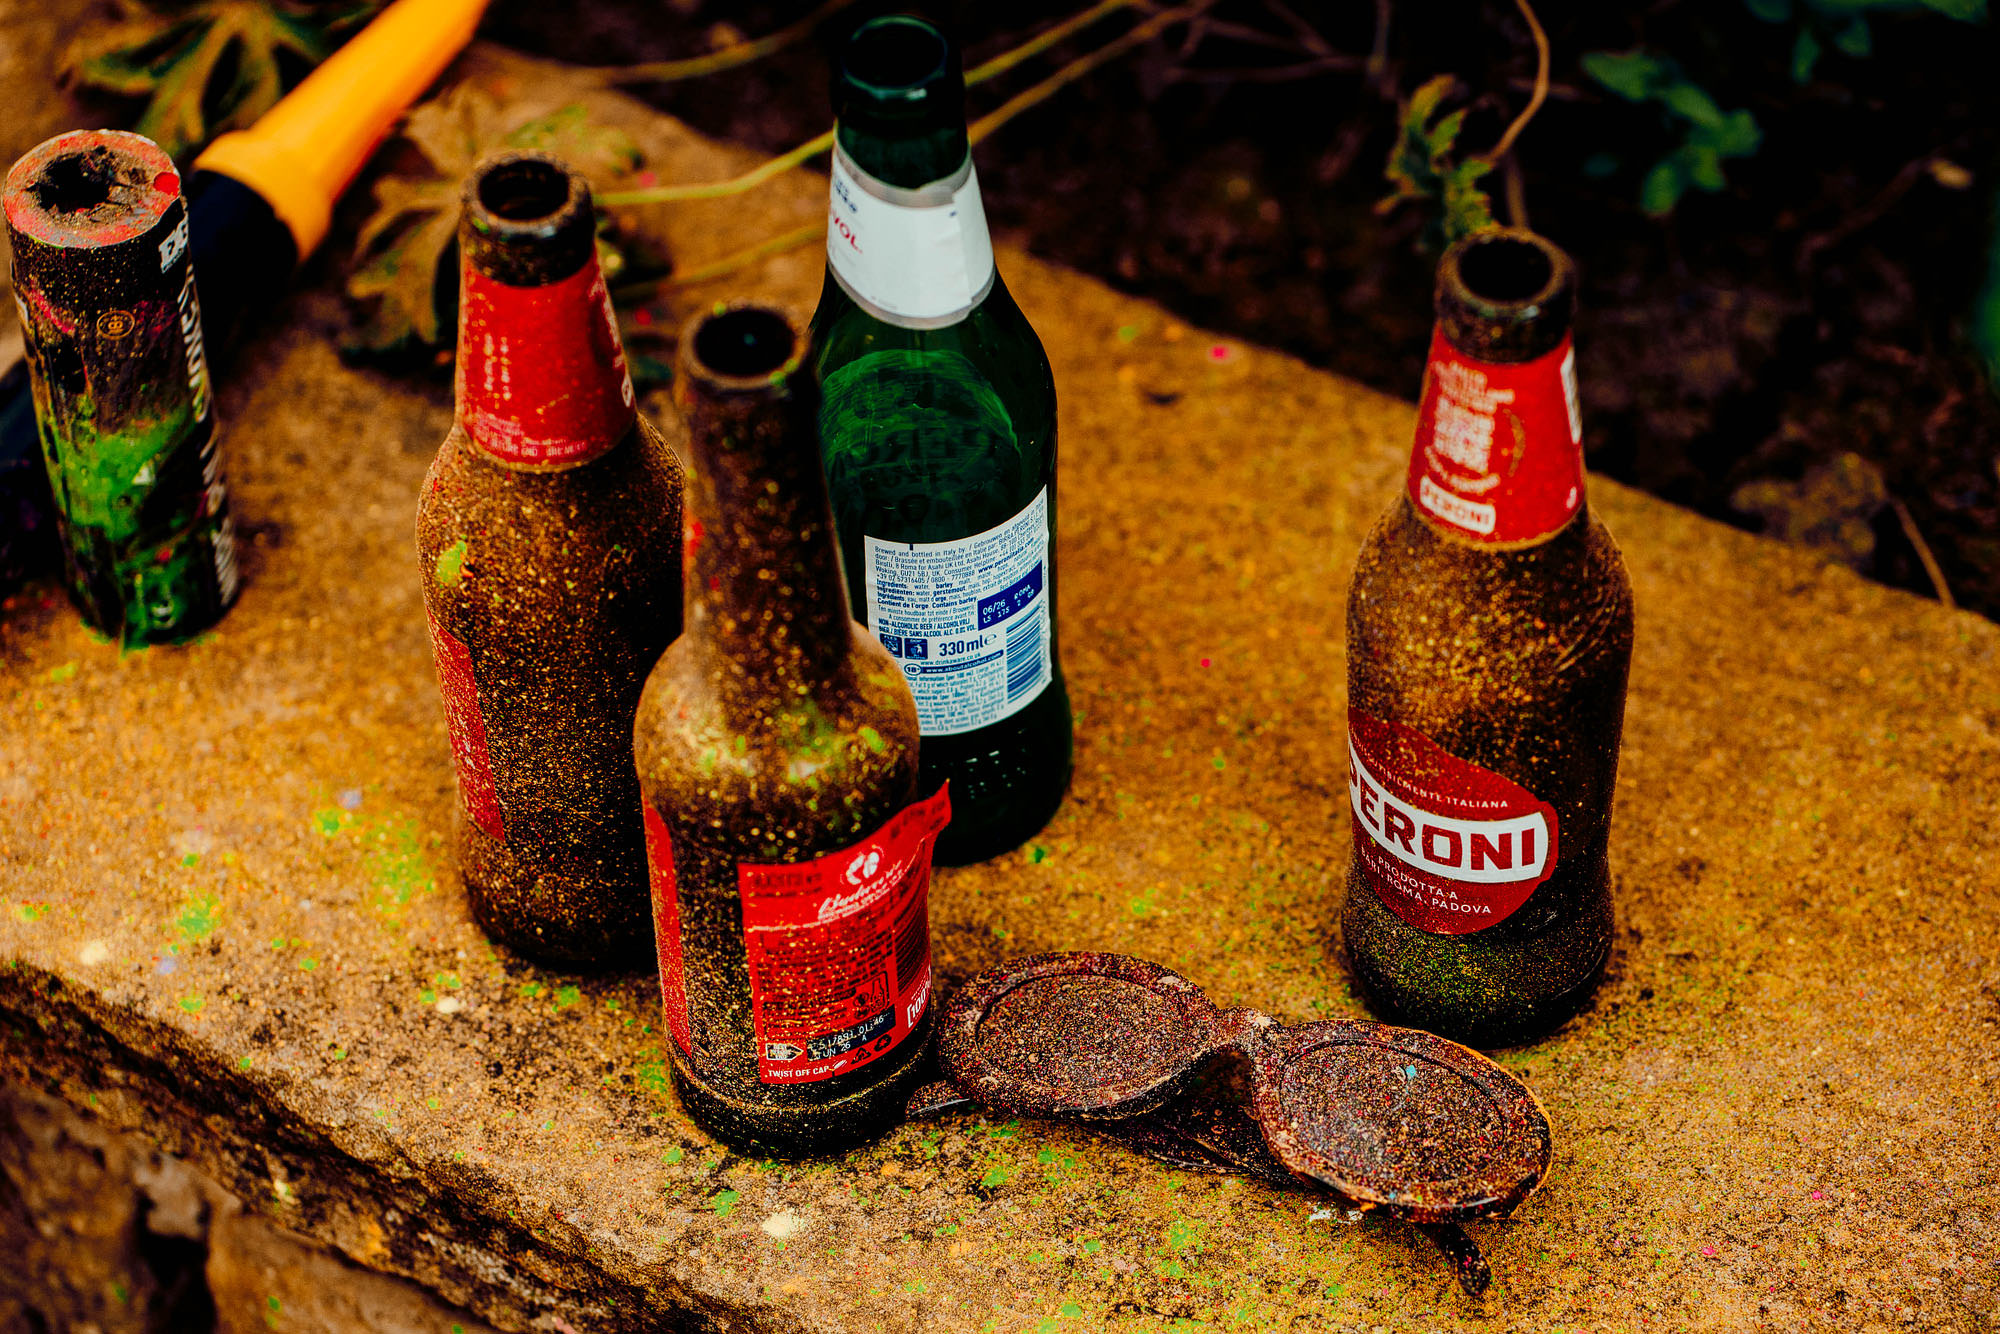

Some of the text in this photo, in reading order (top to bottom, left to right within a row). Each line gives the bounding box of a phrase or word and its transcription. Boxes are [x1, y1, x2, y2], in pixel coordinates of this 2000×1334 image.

[874, 546, 896, 555] Brewed
[944, 548, 956, 556] Italy
[932, 601, 958, 609] Contains
[983, 599, 1006, 615] 06/26
[1447, 796, 1508, 808] ITALIANA
[1378, 856, 1458, 900] PRODOTTA A
[1432, 898, 1492, 914] PADOVA
[768, 1065, 830, 1077] TWIST OFF CAP
